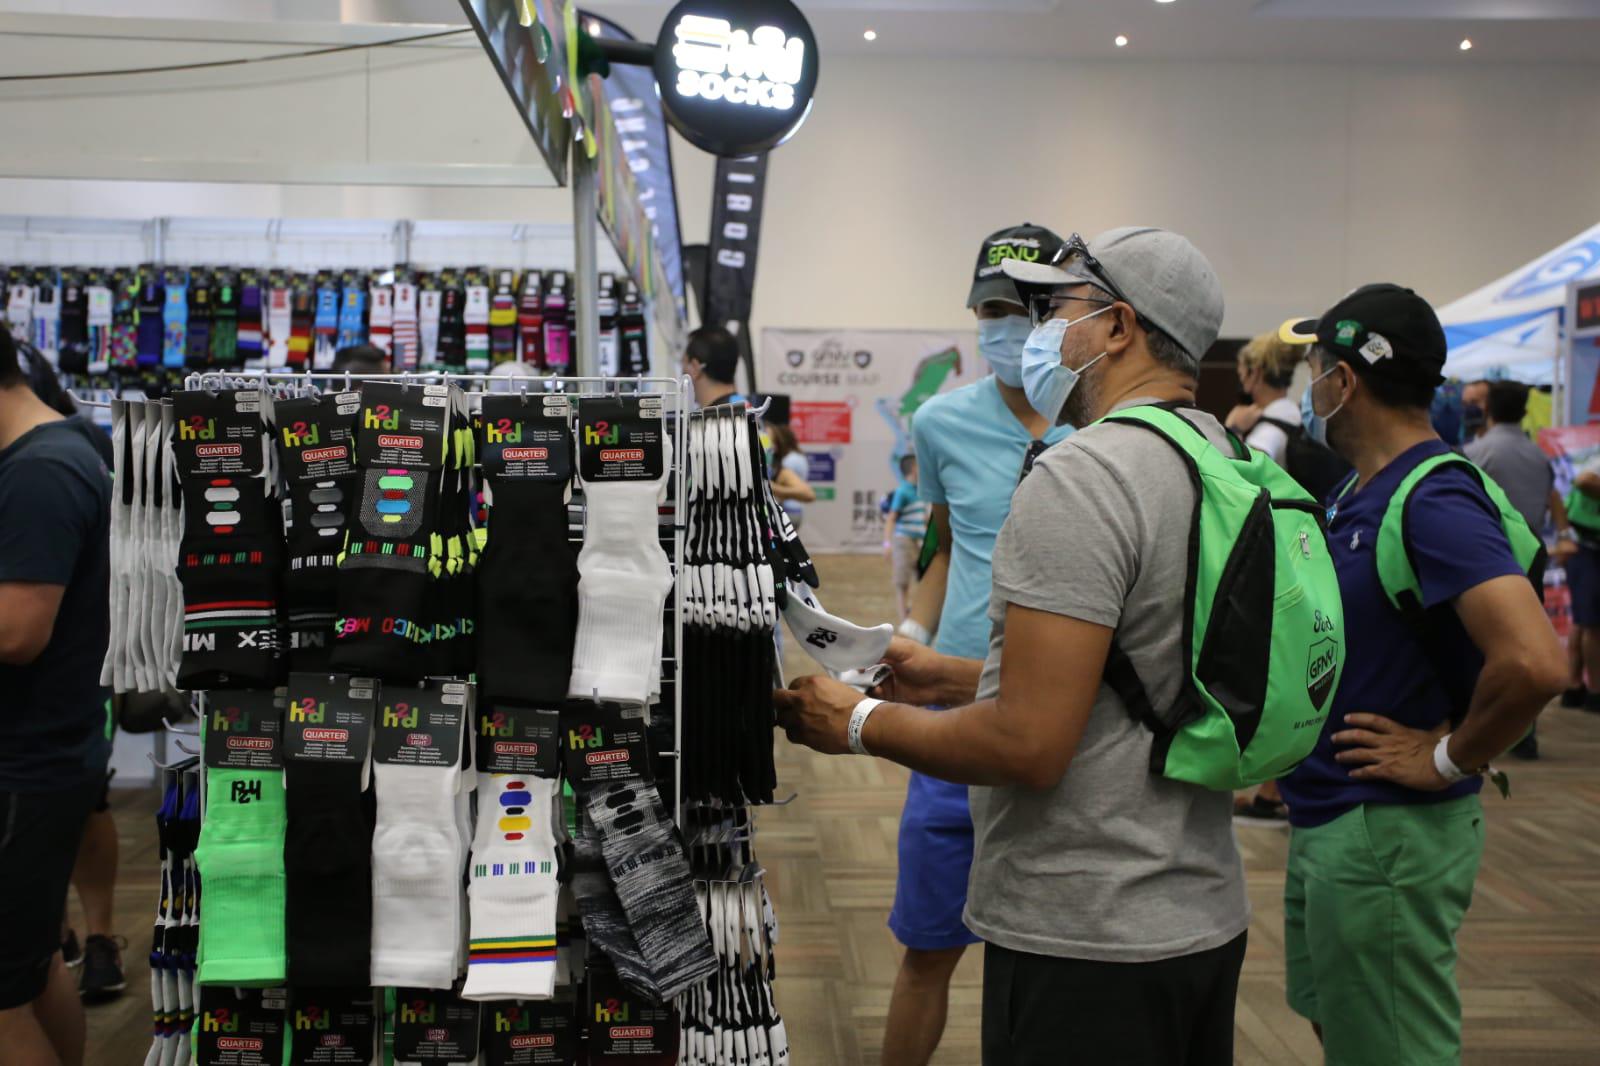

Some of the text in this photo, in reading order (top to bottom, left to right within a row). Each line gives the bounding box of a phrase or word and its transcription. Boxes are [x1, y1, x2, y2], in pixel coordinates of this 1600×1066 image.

[676, 69, 794, 110] SOCKS
[380, 437, 421, 447] QUARTER
[198, 446, 240, 456] QUARTER
[304, 449, 346, 461] QUARTER
[504, 450, 546, 458] QUARTER
[602, 452, 642, 460] QUARTER
[1309, 646, 1334, 679] GFNY
[305, 731, 346, 740] QUARTER
[229, 739, 271, 749] QUARTER
[496, 744, 536, 753] QUARTER
[588, 752, 627, 763] QUARTER
[612, 1028, 651, 1037] QUARTER
[220, 1039, 262, 1049] QUARTER
[512, 1036, 553, 1046] QUARTER
